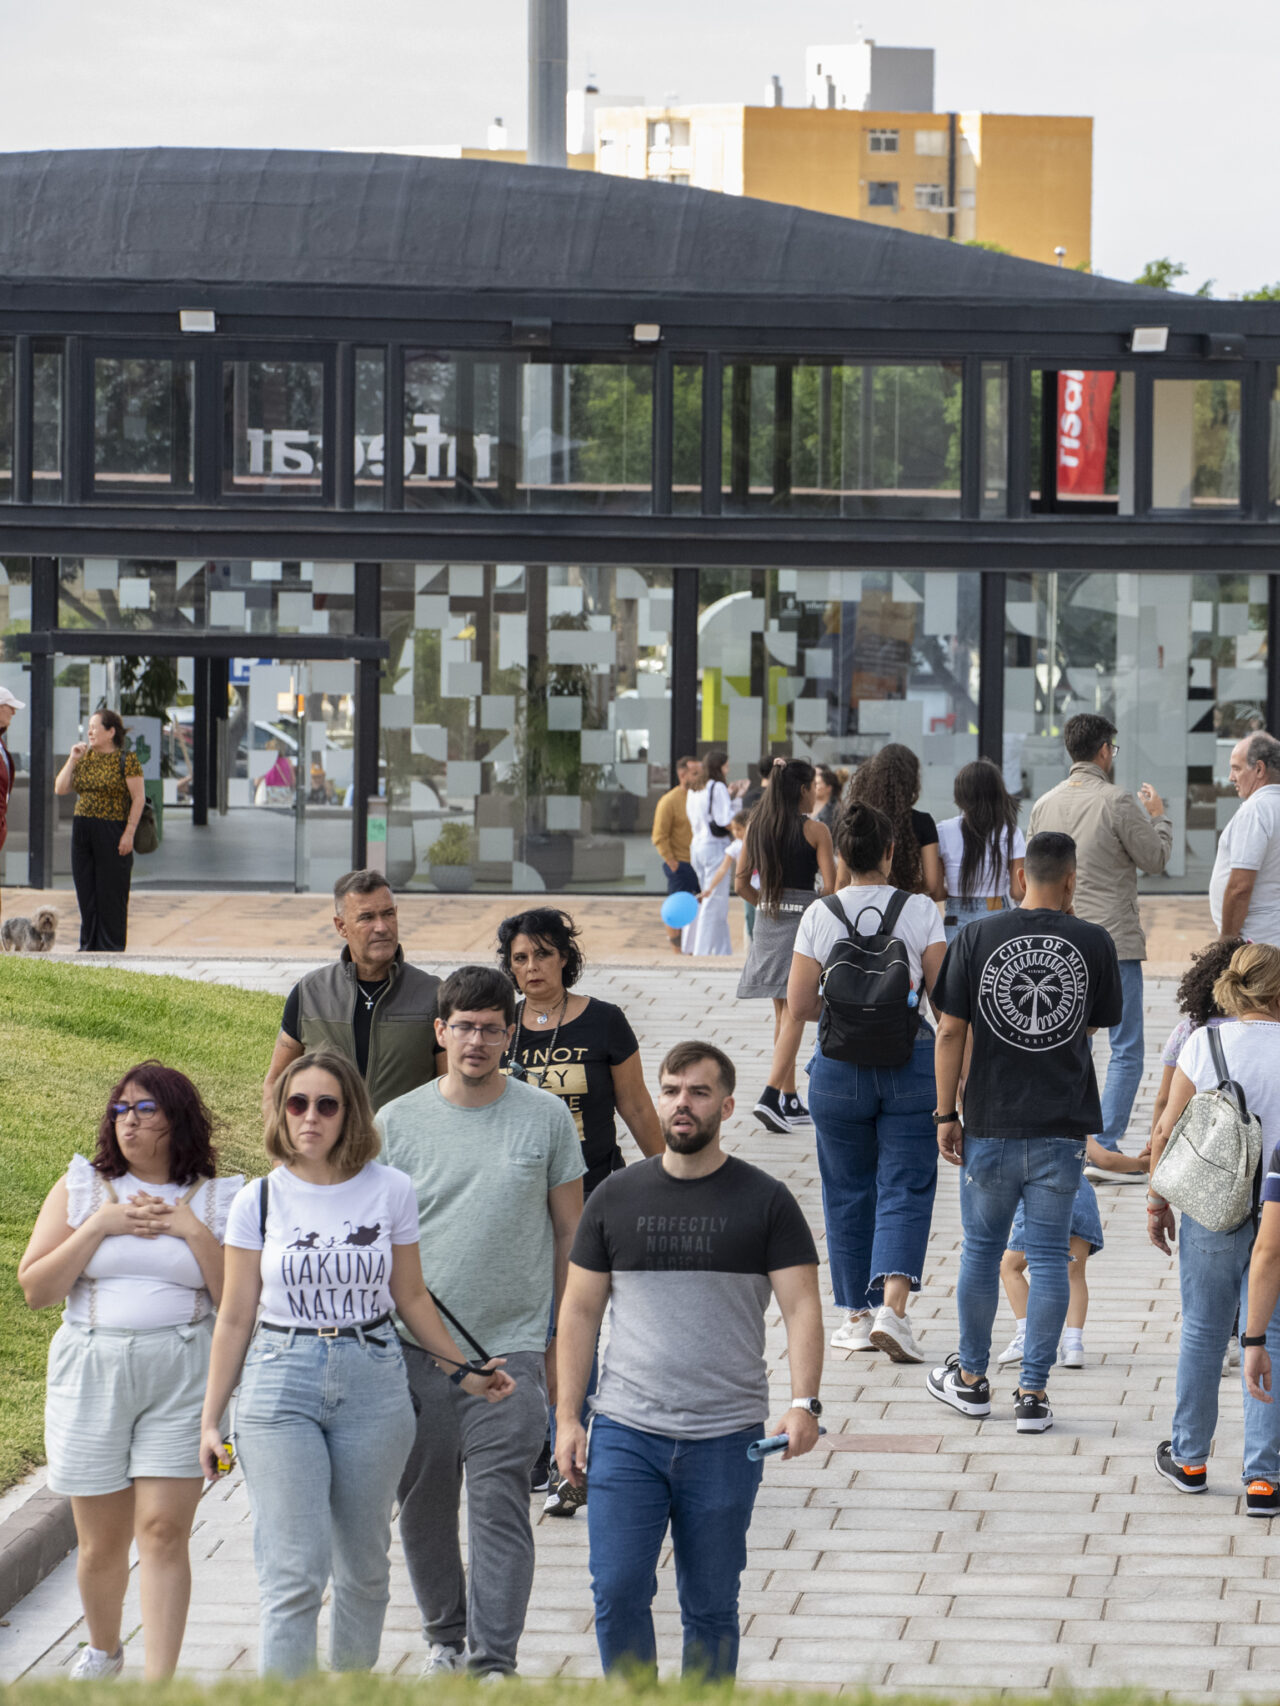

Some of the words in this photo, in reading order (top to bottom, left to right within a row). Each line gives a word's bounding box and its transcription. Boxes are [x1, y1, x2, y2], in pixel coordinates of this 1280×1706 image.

[982, 964, 999, 995] THE
[999, 938, 1034, 961] CITY
[1042, 939, 1064, 951] OF
[1066, 951, 1087, 1000] MIAMI
[1009, 1031, 1062, 1045] FLORIDA
[637, 1216, 727, 1233] PERFECTLY
[646, 1236, 714, 1253] NORMAL
[282, 1252, 386, 1287] HAKUNA
